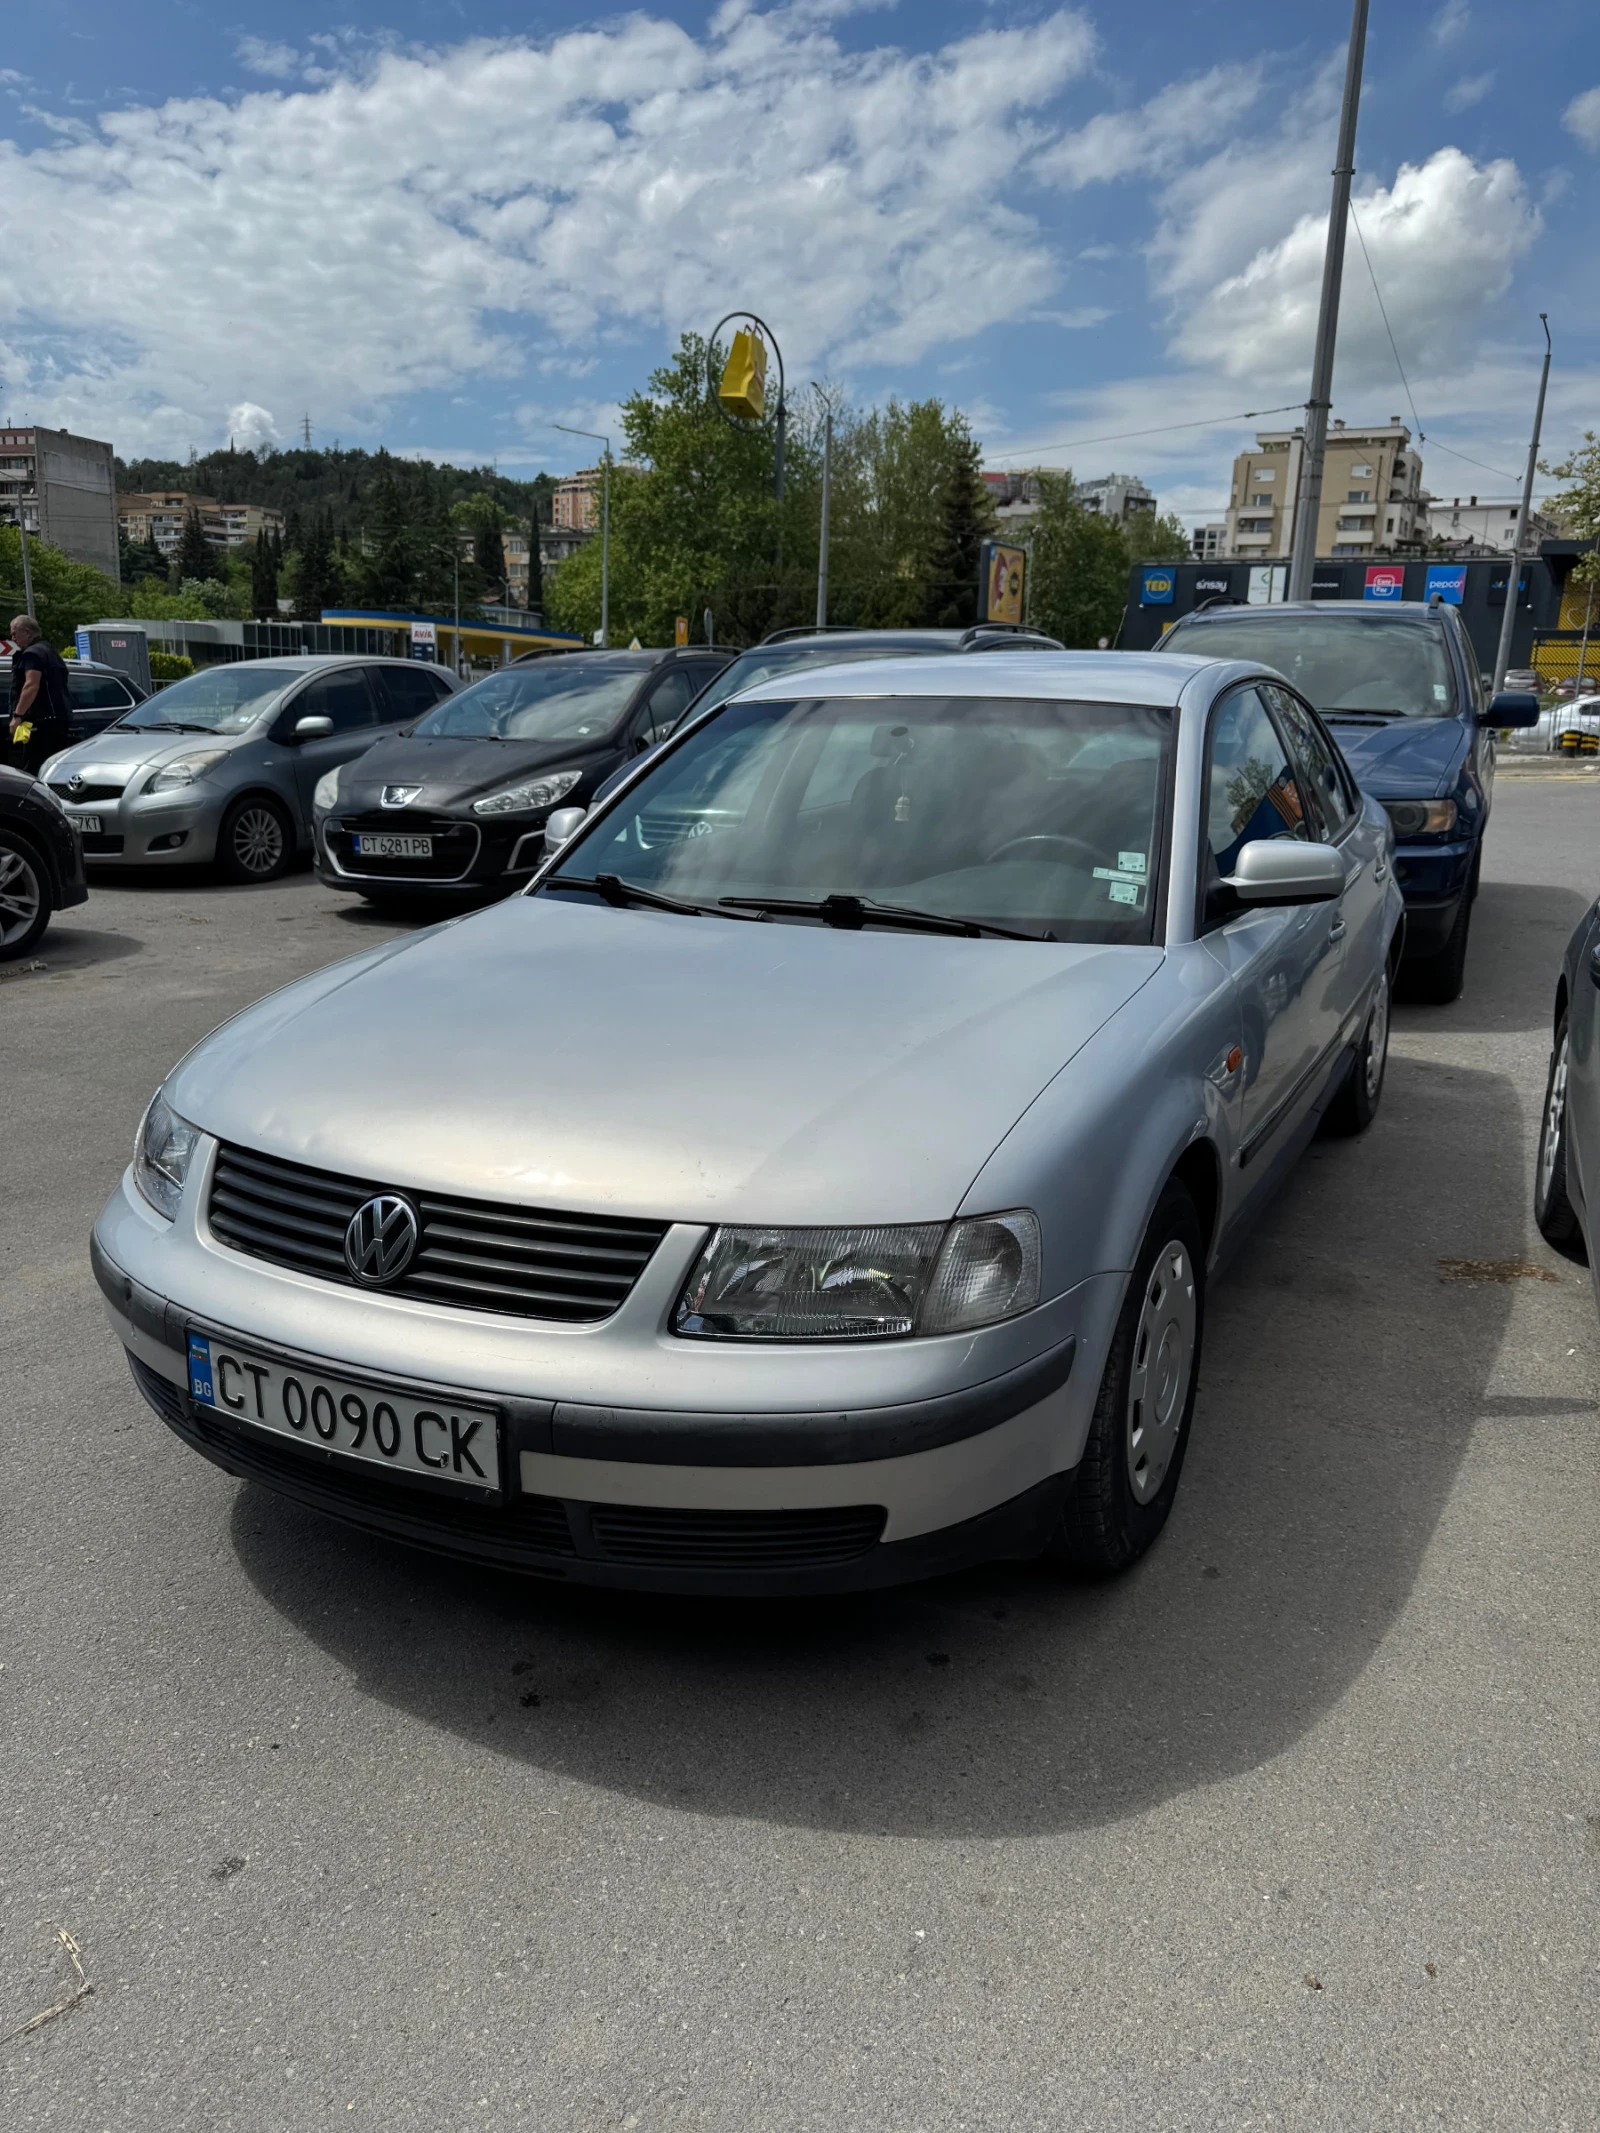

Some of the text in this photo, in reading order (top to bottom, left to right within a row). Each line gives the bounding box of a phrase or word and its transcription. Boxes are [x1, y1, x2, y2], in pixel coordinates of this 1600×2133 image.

[1429, 580, 1460, 589] pepco
[362, 837, 430, 854] CT 6281 PB
[194, 1378, 213, 1397] BG
[217, 1354, 488, 1478] CT 0090 CK
